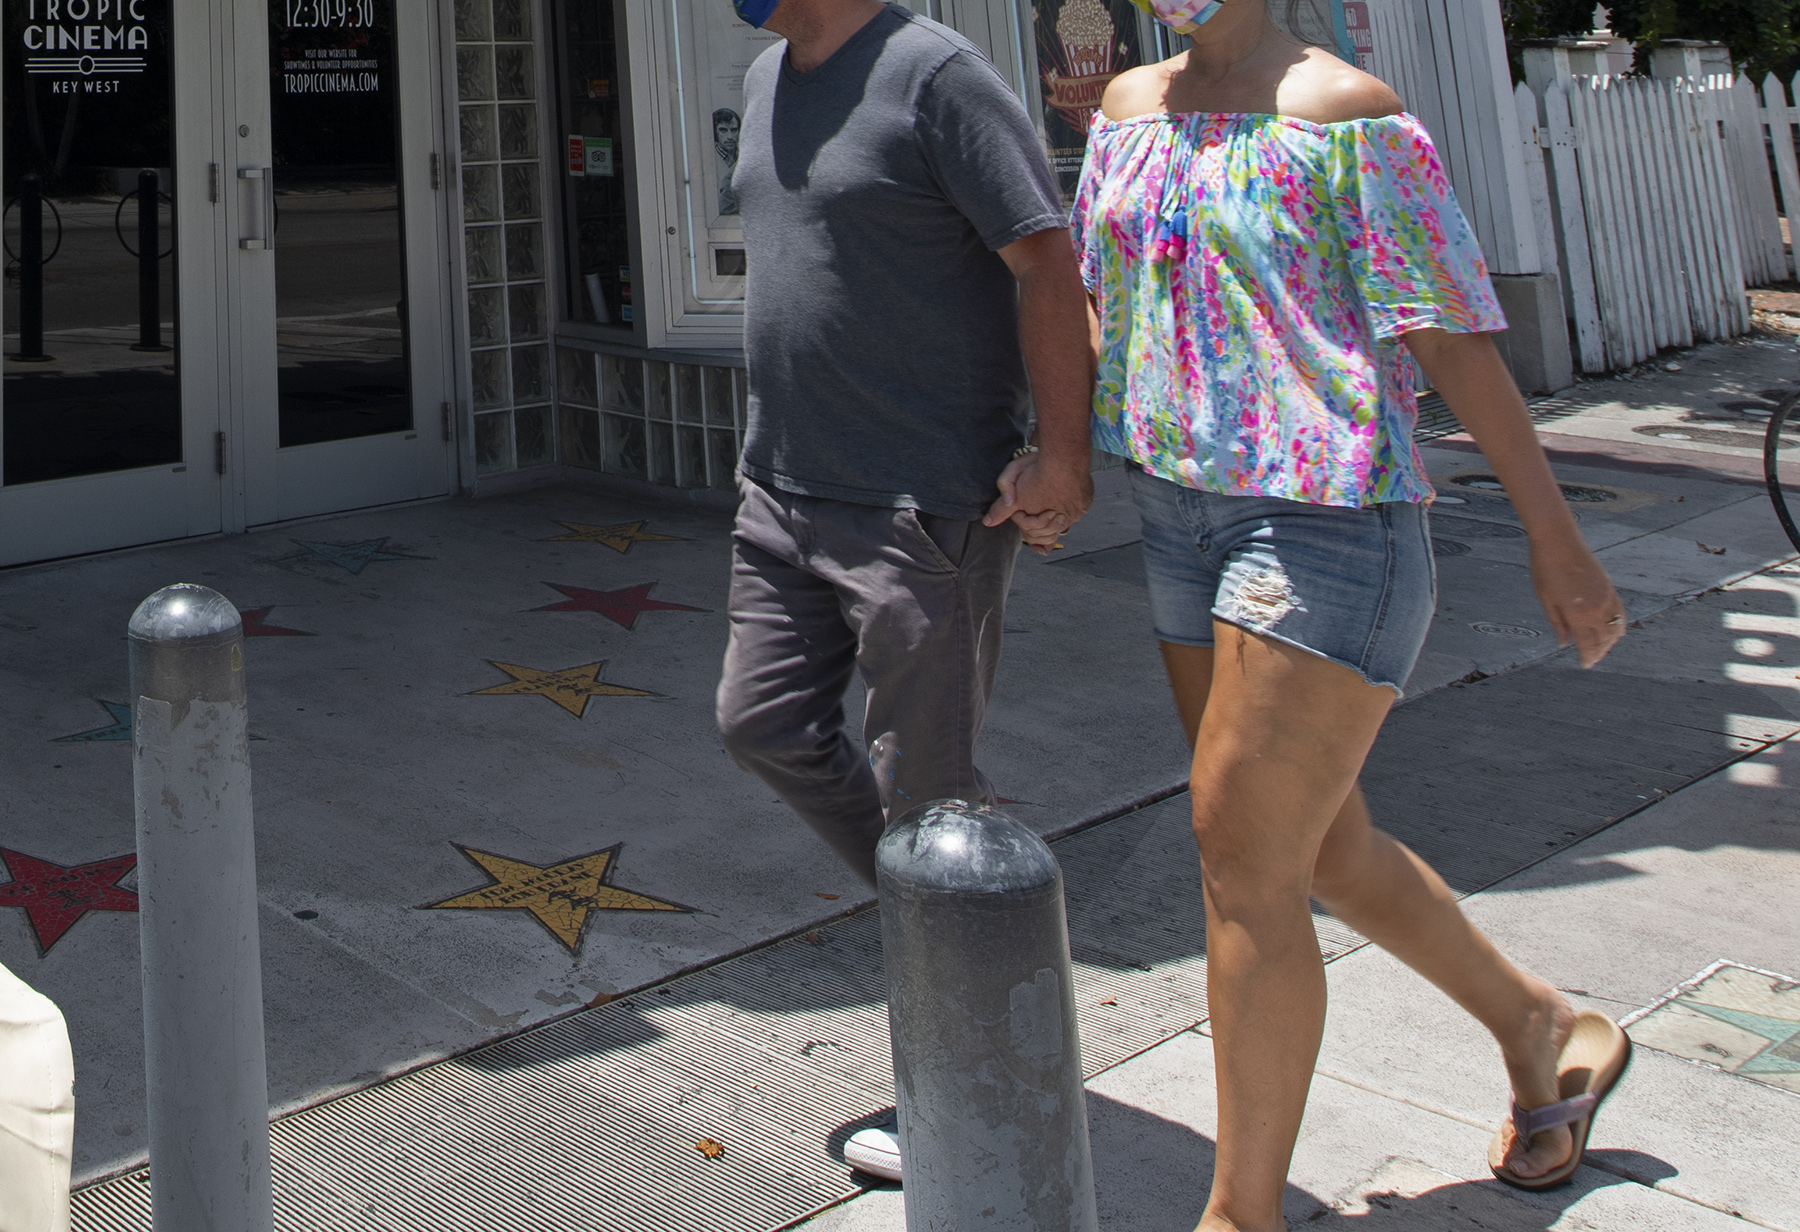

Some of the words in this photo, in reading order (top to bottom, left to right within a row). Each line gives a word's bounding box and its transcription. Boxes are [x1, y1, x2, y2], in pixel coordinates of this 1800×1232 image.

[1345, 7, 1358, 27] NO
[23, 24, 148, 51] CINEMA
[52, 81, 78, 94] KEY
[84, 80, 120, 94] WEST
[284, 72, 379, 93] TROPICCINEMA.COM
[1047, 147, 1072, 156] OLUNTEER
[1067, 156, 1084, 164] ATTEND
